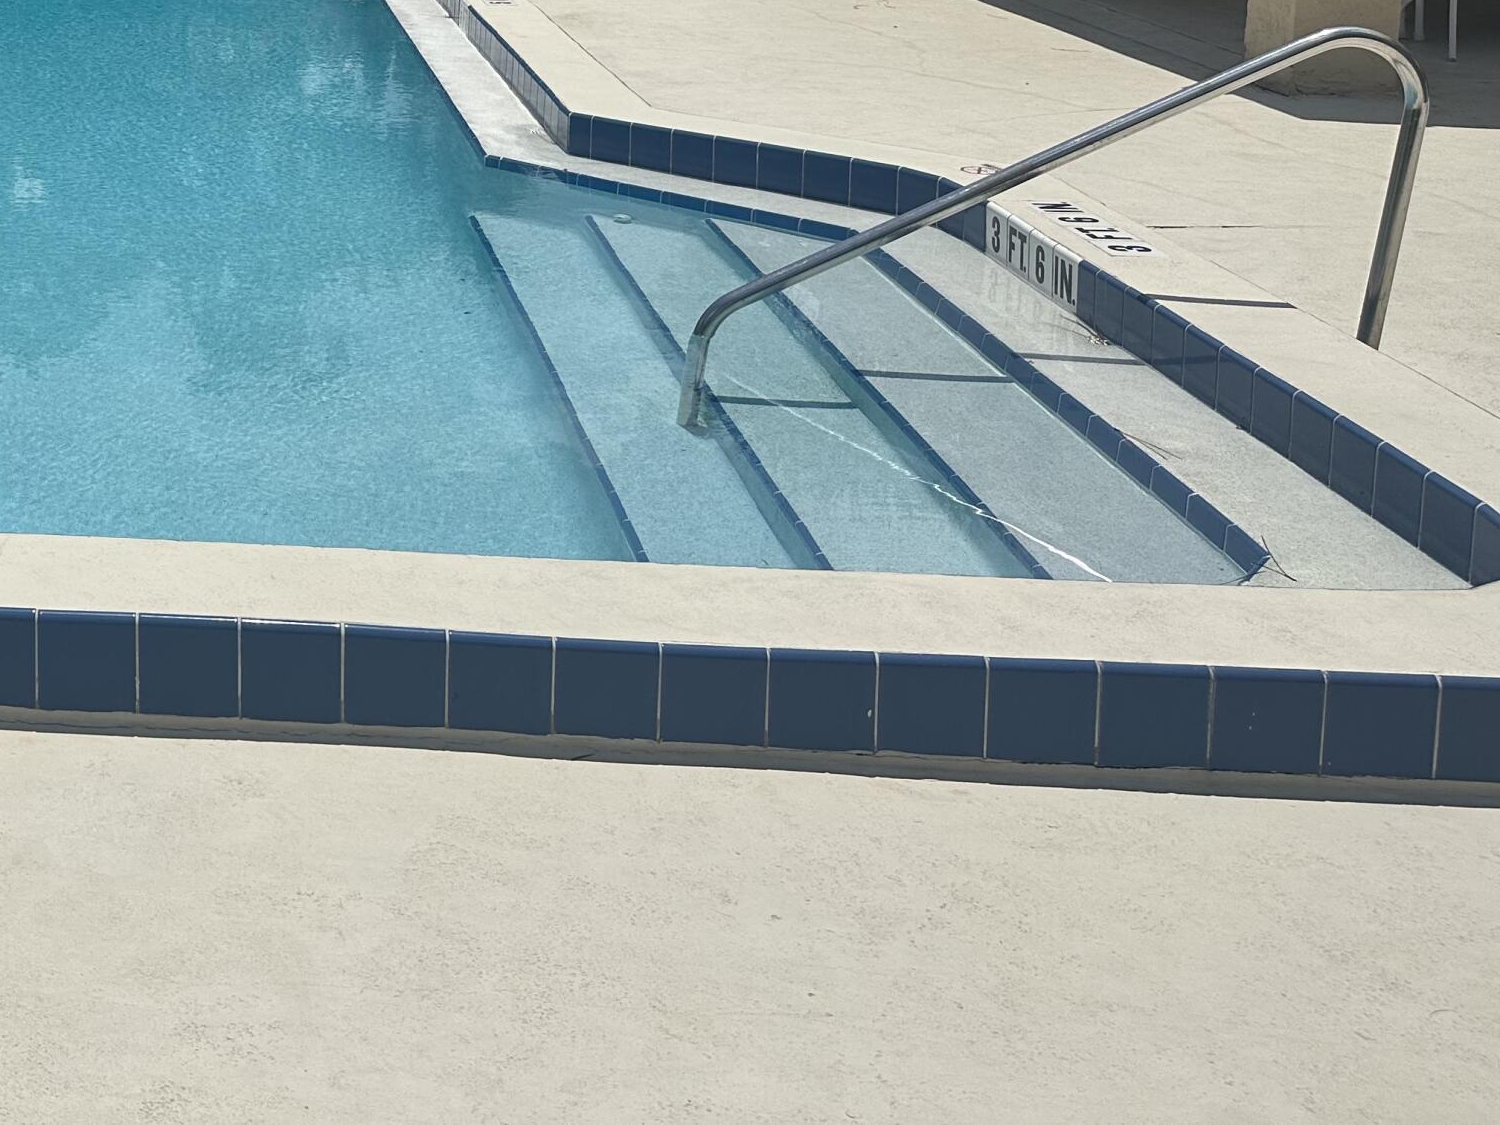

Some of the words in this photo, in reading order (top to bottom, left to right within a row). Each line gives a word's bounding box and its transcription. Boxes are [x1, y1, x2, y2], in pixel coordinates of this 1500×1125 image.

[991, 215, 1001, 254] 3
[1008, 227, 1027, 273] FT.
[1035, 244, 1045, 284] 6
[1054, 255, 1076, 306] IN.
[1107, 245, 1152, 253] 3
